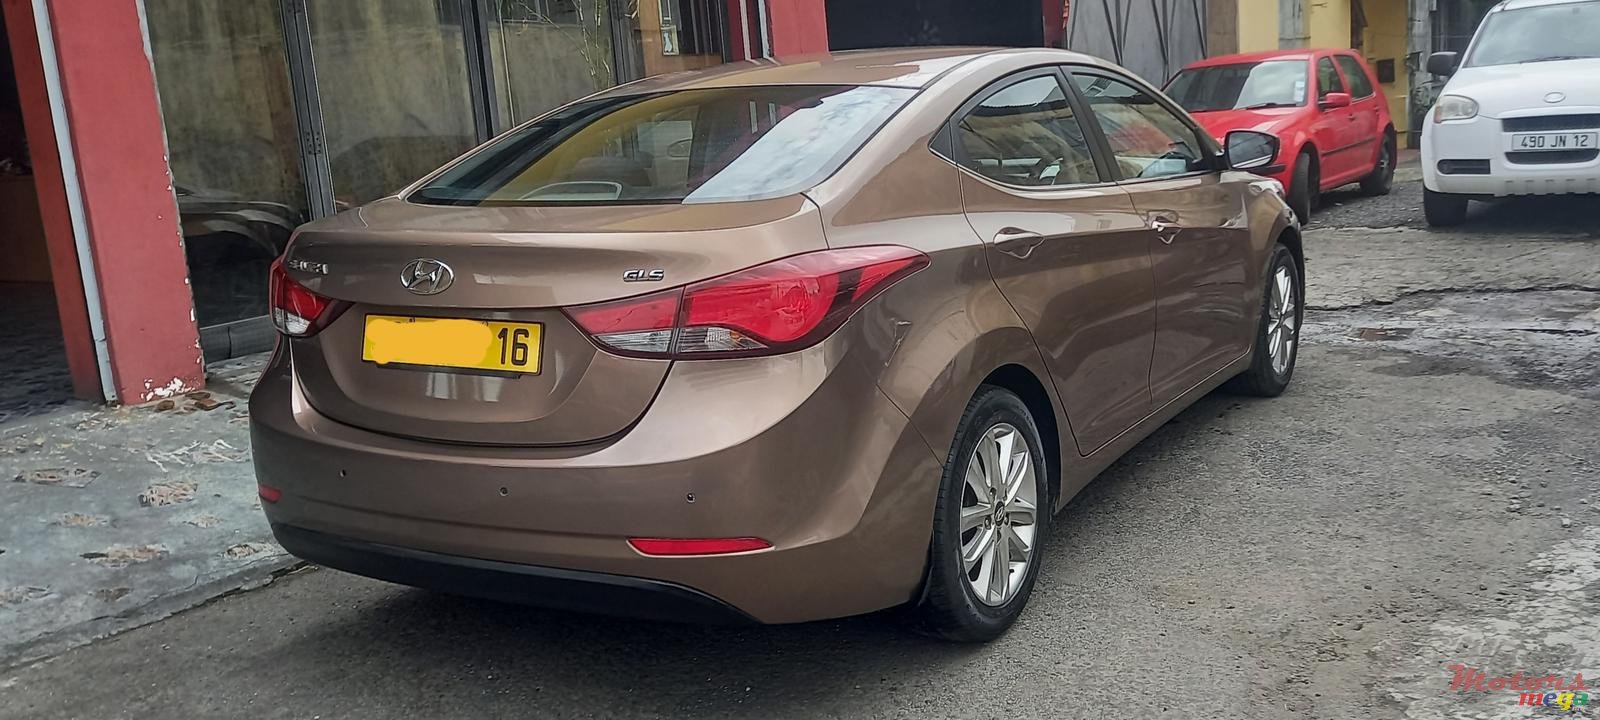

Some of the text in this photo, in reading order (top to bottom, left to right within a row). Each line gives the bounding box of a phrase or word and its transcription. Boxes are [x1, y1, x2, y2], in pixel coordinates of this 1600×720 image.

[1521, 134, 1588, 148] 490 JN 12
[623, 269, 664, 282] GLS
[498, 327, 529, 366] 16
